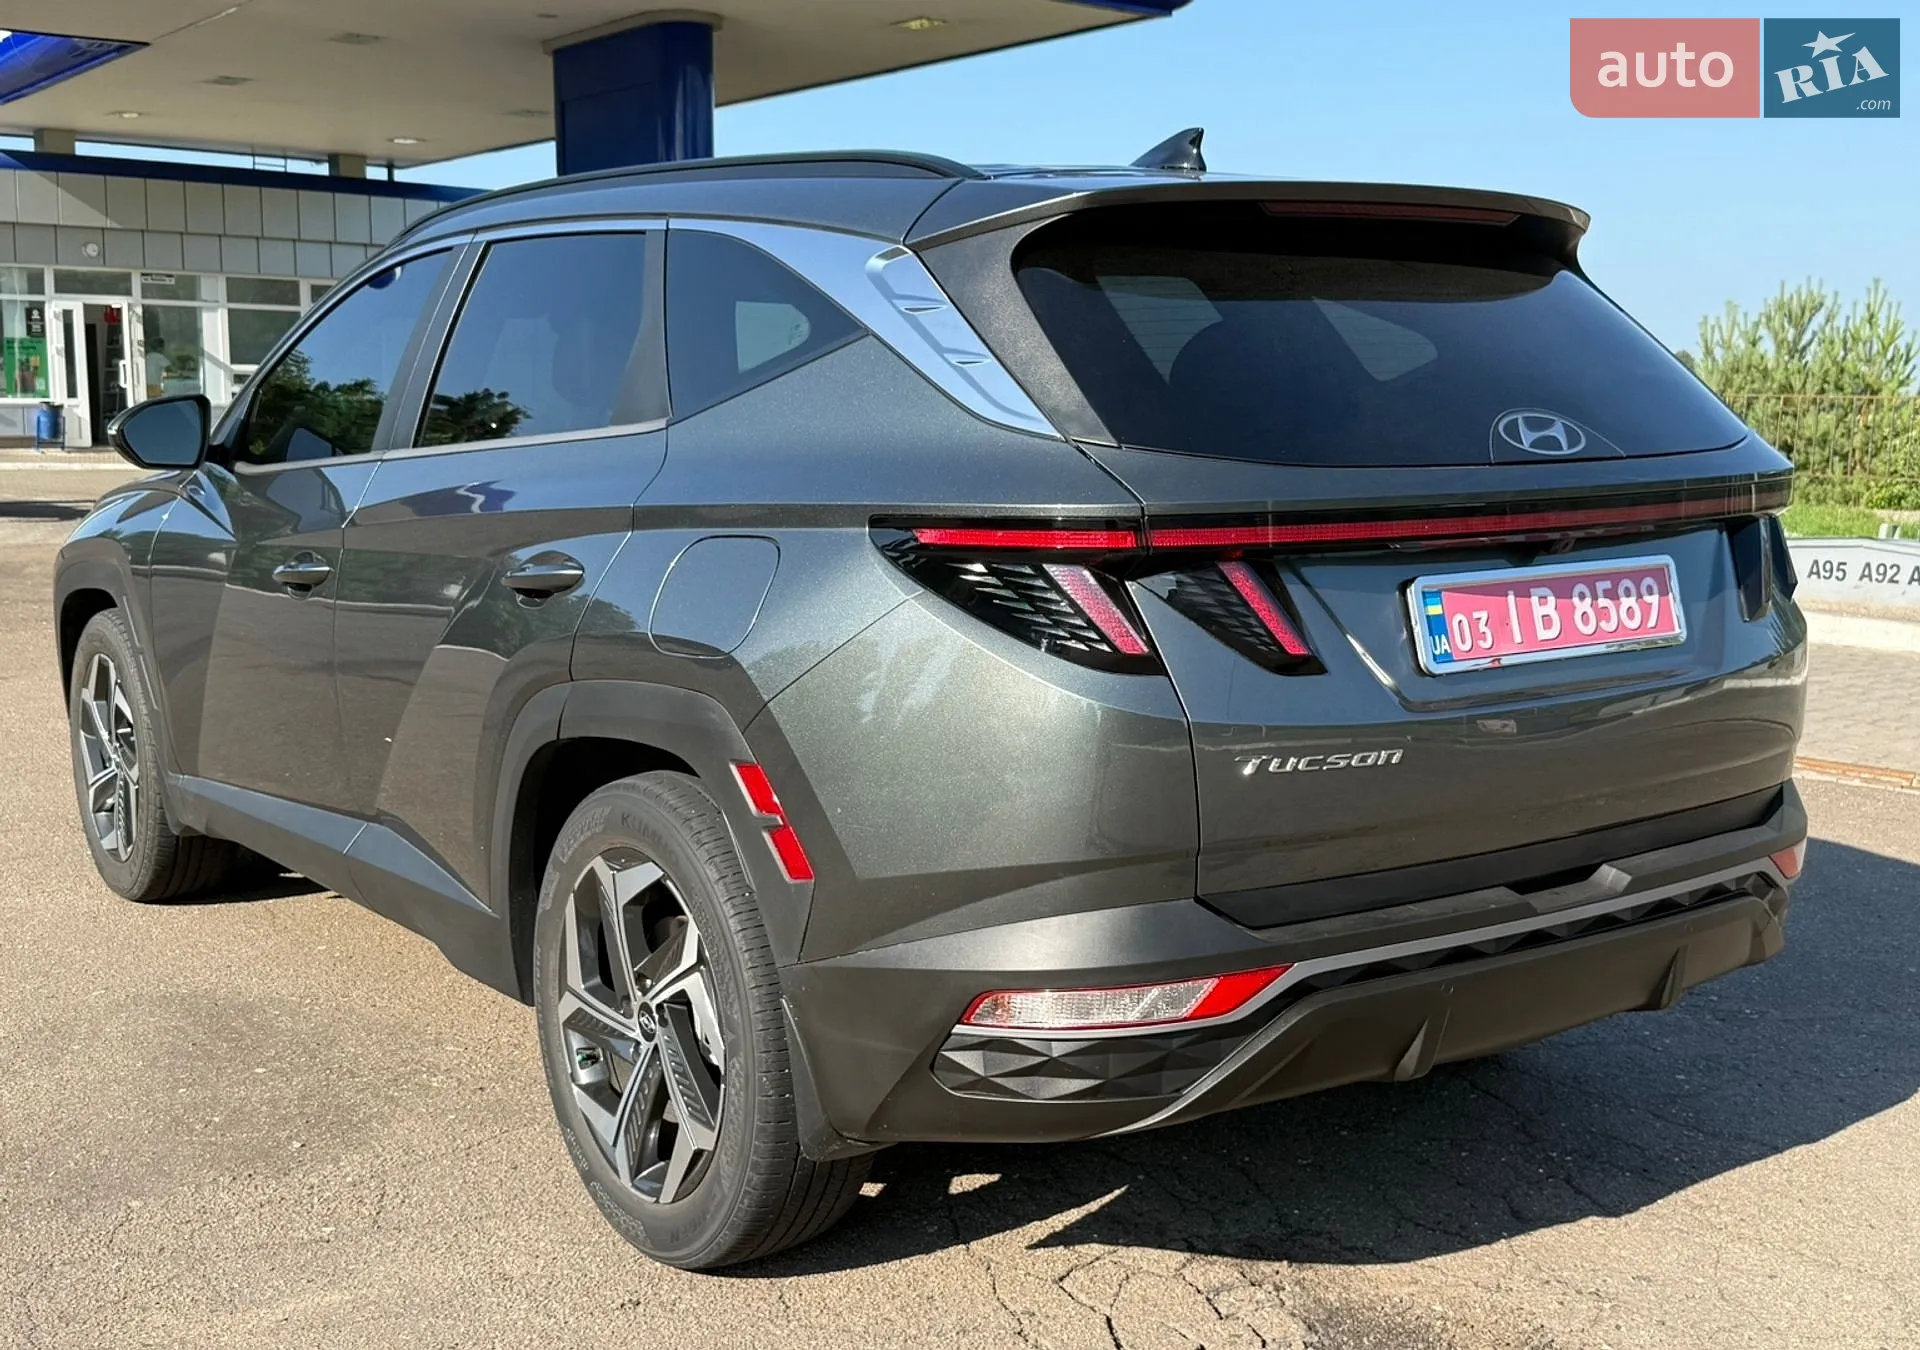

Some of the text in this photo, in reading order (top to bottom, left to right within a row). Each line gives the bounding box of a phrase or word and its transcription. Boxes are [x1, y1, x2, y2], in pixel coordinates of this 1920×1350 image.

[1807, 560, 1847, 581] A95
[1859, 562, 1901, 584] A92
[1452, 610, 1494, 652] 03
[1572, 576, 1660, 635] 8589
[1431, 634, 1452, 656] UA
